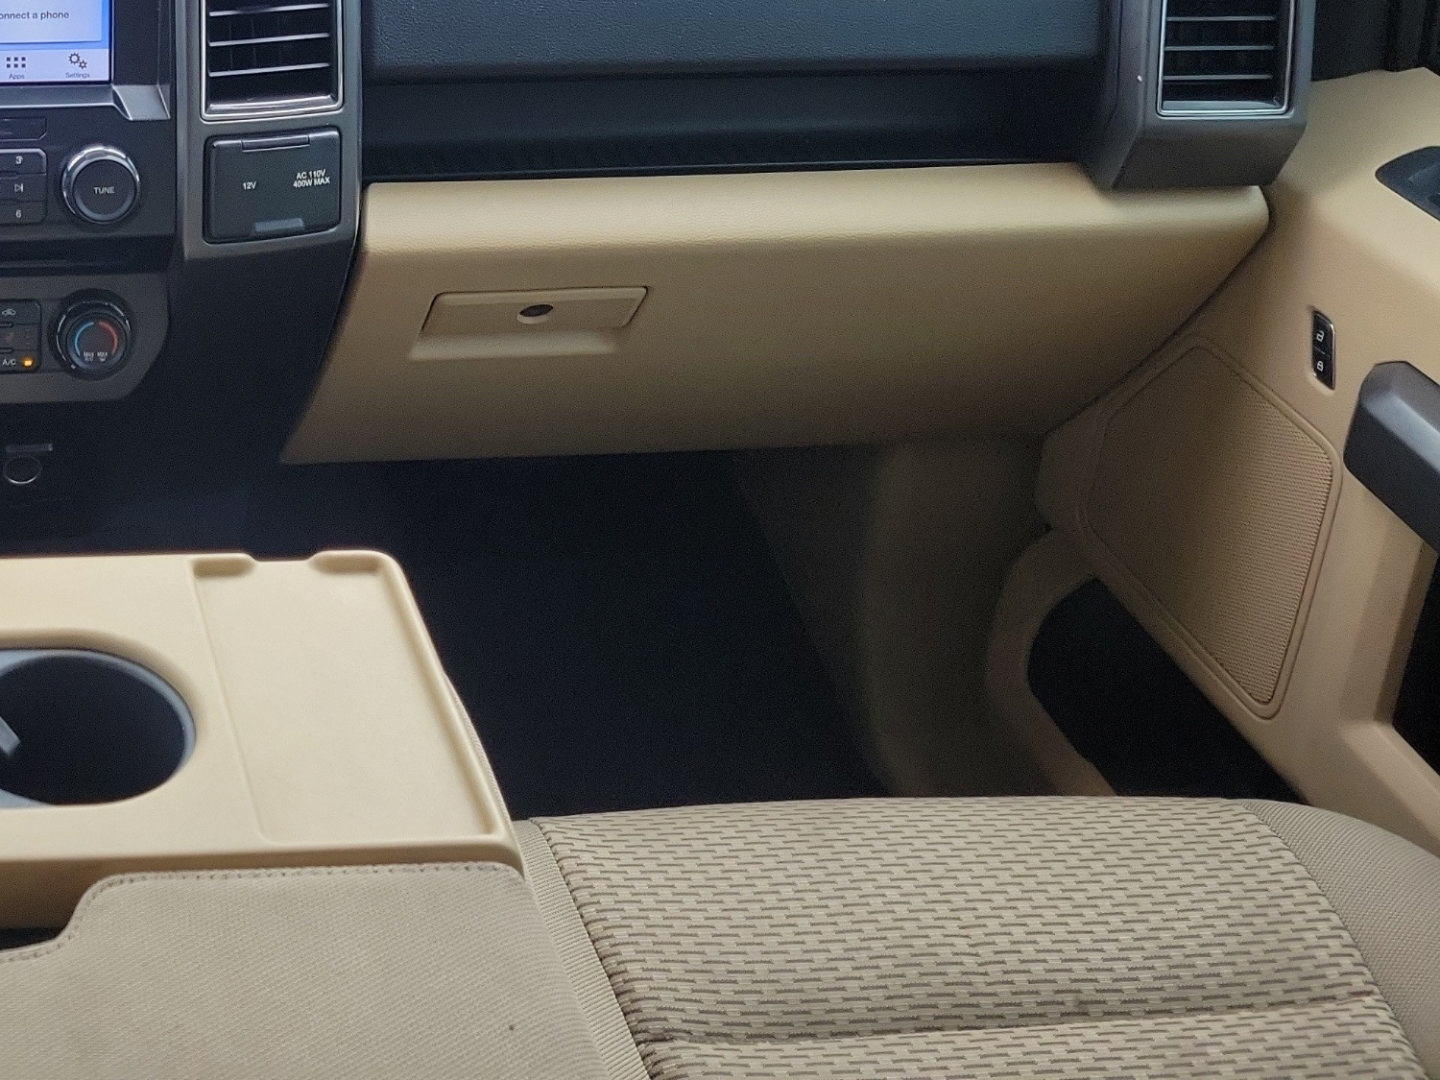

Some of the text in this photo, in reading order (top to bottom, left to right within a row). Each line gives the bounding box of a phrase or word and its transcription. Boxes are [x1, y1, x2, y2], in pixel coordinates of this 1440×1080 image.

[40, 11, 69, 21] phone
[8, 73, 25, 81] Apps
[65, 71, 90, 80] Settings
[296, 168, 326, 180] AC 110V
[242, 180, 257, 190] 12V
[292, 176, 330, 188] 400W MAX
[93, 186, 115, 195] TUNE
[2, 358, 17, 366] A/C
